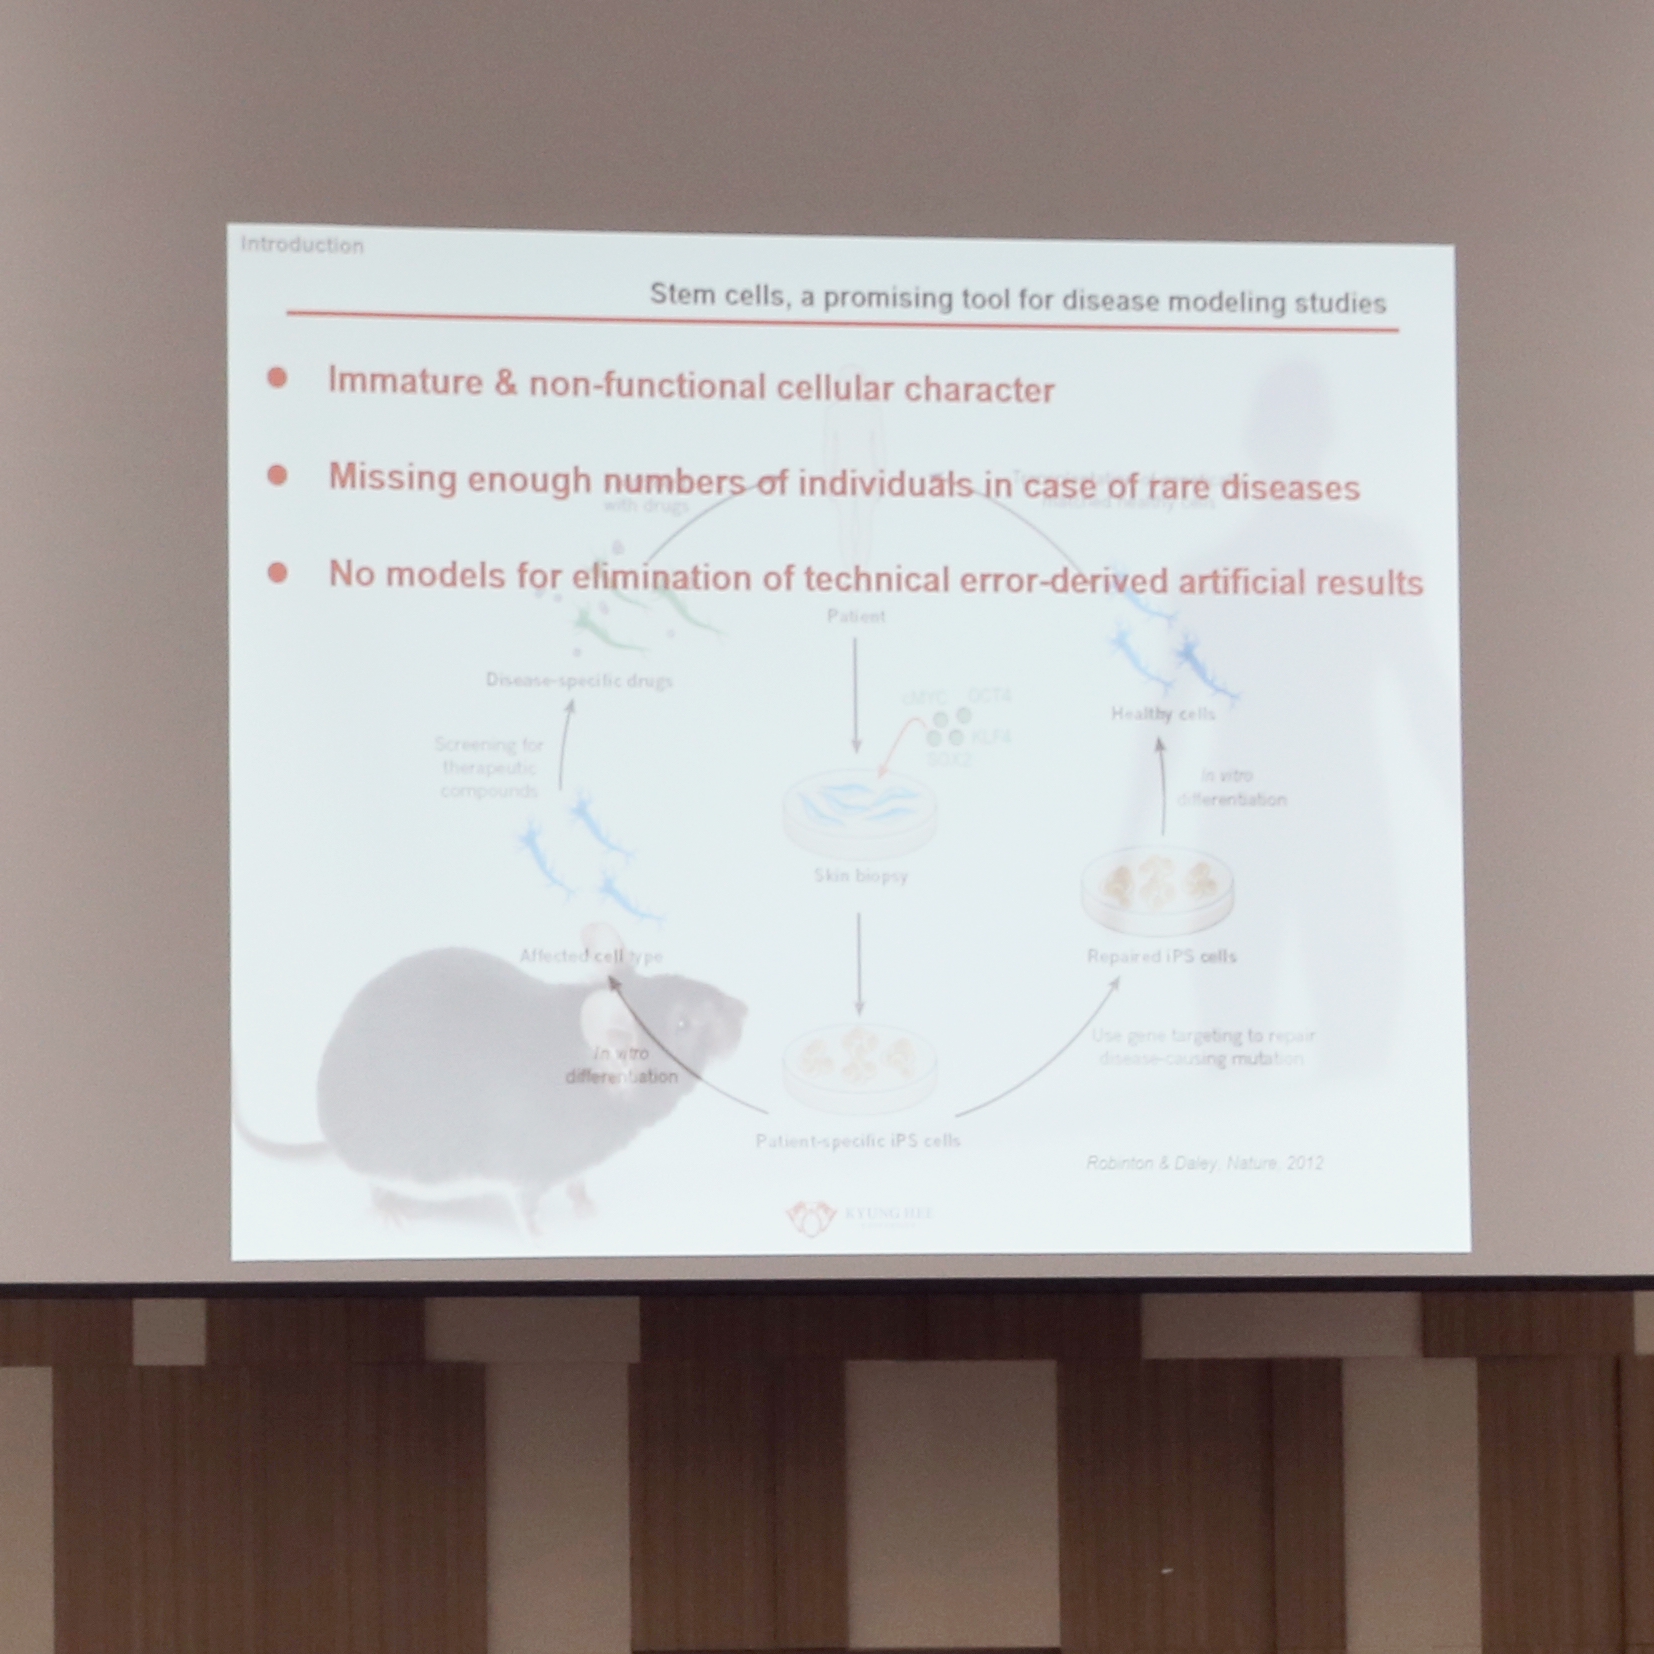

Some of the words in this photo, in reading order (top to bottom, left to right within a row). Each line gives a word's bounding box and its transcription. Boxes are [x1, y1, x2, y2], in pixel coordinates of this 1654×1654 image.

[242, 234, 364, 255] Introduction
[650, 282, 715, 306] Stem
[725, 284, 792, 311] cells,
[800, 290, 815, 307] a
[824, 285, 953, 314] promising
[961, 288, 1010, 311] tool
[1020, 288, 1054, 311] for
[1063, 289, 1160, 312] disease
[1168, 290, 1287, 317] modeling
[1295, 291, 1387, 315] studies
[329, 364, 484, 395] Immature
[495, 367, 517, 395] &
[529, 368, 766, 401] non-functional
[777, 372, 895, 402] cellular
[905, 374, 1057, 405] character
[329, 462, 457, 499] Missing
[468, 465, 592, 501] enough
[604, 466, 746, 496] numbers
[757, 467, 790, 496] of
[800, 468, 974, 499] individuals
[985, 469, 1013, 499] in
[1024, 477, 1097, 500] case
[1108, 472, 1140, 501] of
[1150, 478, 1210, 501] rare
[1222, 474, 1362, 503] diseases
[329, 558, 375, 587] No
[387, 560, 506, 590] models
[518, 560, 563, 590] for
[573, 561, 751, 591] elimination
[763, 562, 796, 591] of
[804, 564, 950, 593] technical
[960, 566, 1169, 595] error-derived
[1179, 567, 1306, 595] artificial
[1316, 568, 1425, 597] results
[828, 607, 886, 625] Patient
[486, 671, 622, 692] Disease-specific
[628, 672, 674, 692] drugs
[1111, 705, 1172, 725] Healthy
[1178, 705, 1216, 723] cells
[435, 736, 517, 756] Screening
[522, 736, 544, 753] for
[444, 760, 537, 780] therapeutic
[1220, 768, 1254, 784] vitro
[441, 782, 538, 802] compounds
[1178, 791, 1288, 808] differentiation
[814, 867, 849, 885] Skin
[856, 867, 908, 888] biopsy
[520, 946, 589, 964] Affected
[595, 946, 624, 964] cell
[1087, 949, 1161, 967] Repaired
[1166, 949, 1195, 965] iPS
[1201, 948, 1237, 965] cells
[1092, 1028, 1121, 1044] Use
[1128, 1032, 1166, 1048] gene
[1173, 1028, 1243, 1048] targeting
[1248, 1029, 1263, 1044] to
[1269, 1028, 1316, 1048] repair
[1099, 1051, 1226, 1070] disease-causing
[1232, 1051, 1305, 1067] mutation
[756, 1132, 886, 1152] Patient-specific
[890, 1133, 918, 1149] iPS
[924, 1133, 961, 1149] cells
[1087, 1156, 1154, 1172] Robinton
[1159, 1156, 1170, 1171] &
[1287, 1156, 1325, 1172] 2012
